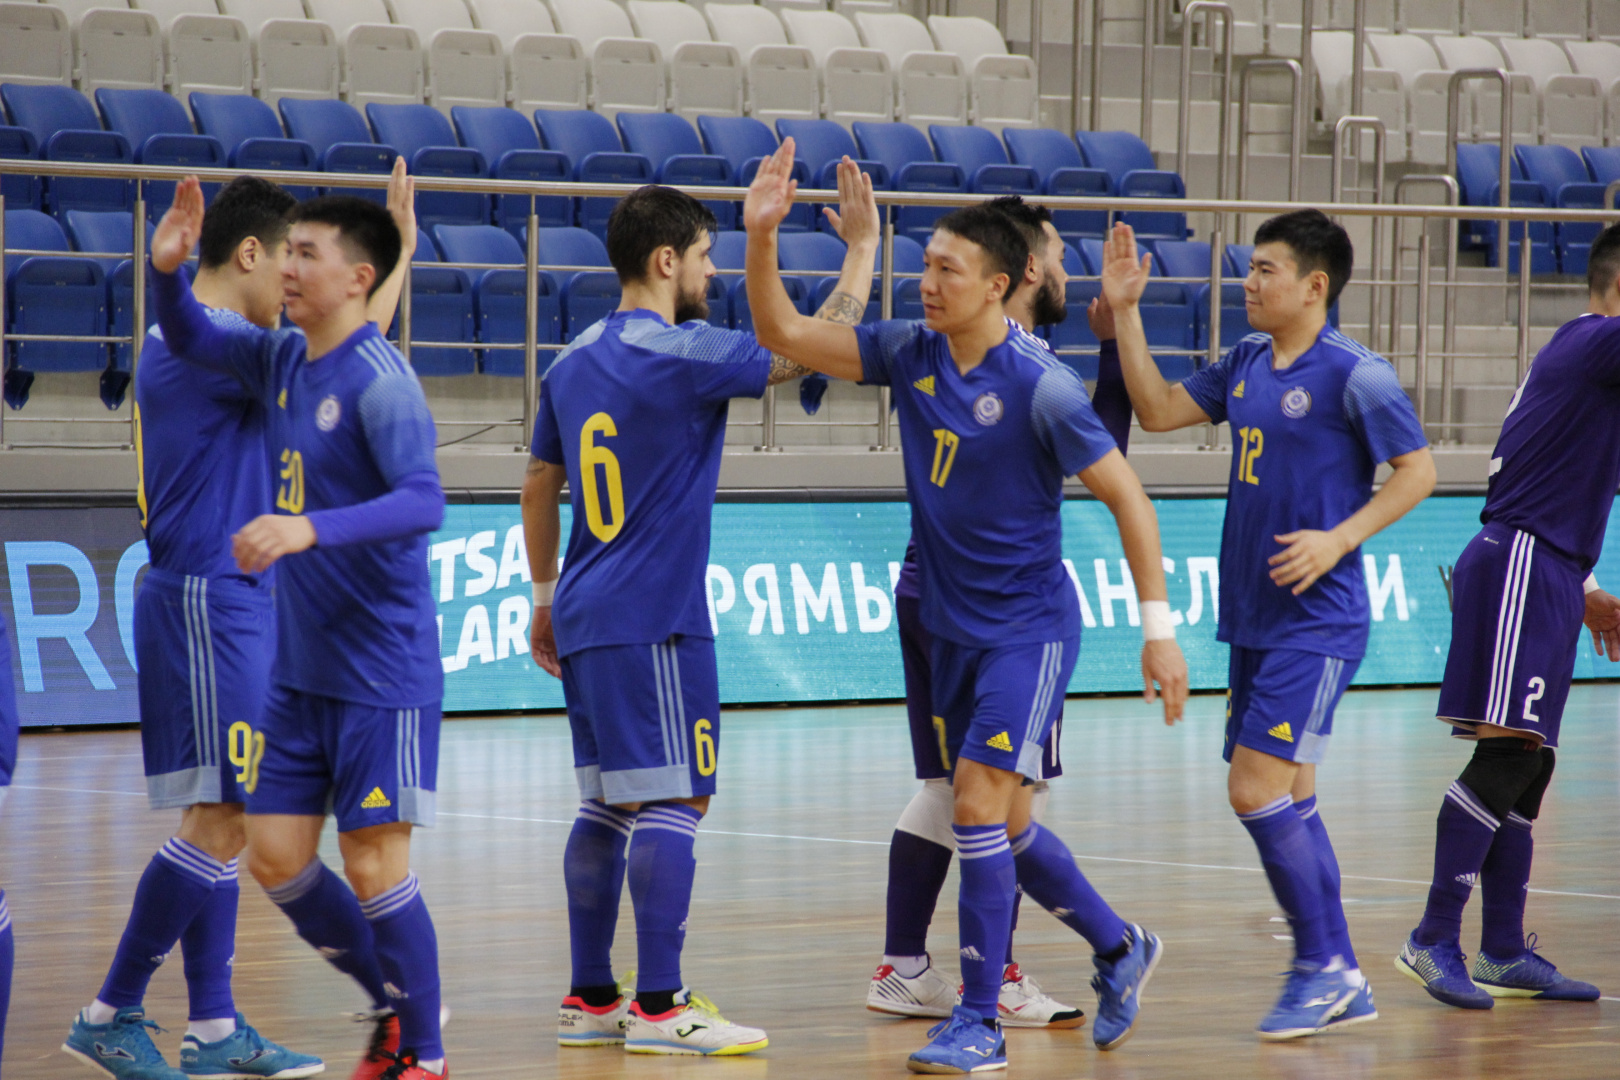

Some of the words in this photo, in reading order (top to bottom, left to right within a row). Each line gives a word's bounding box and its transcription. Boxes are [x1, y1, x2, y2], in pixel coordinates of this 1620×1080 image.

[276, 448, 305, 514] 20
[580, 412, 625, 543] 6
[930, 428, 960, 488] 17
[1238, 426, 1264, 486] 12
[427, 524, 566, 603] TSA
[1522, 676, 1545, 723] 2
[228, 720, 252, 783] 9
[694, 718, 716, 776] 6
